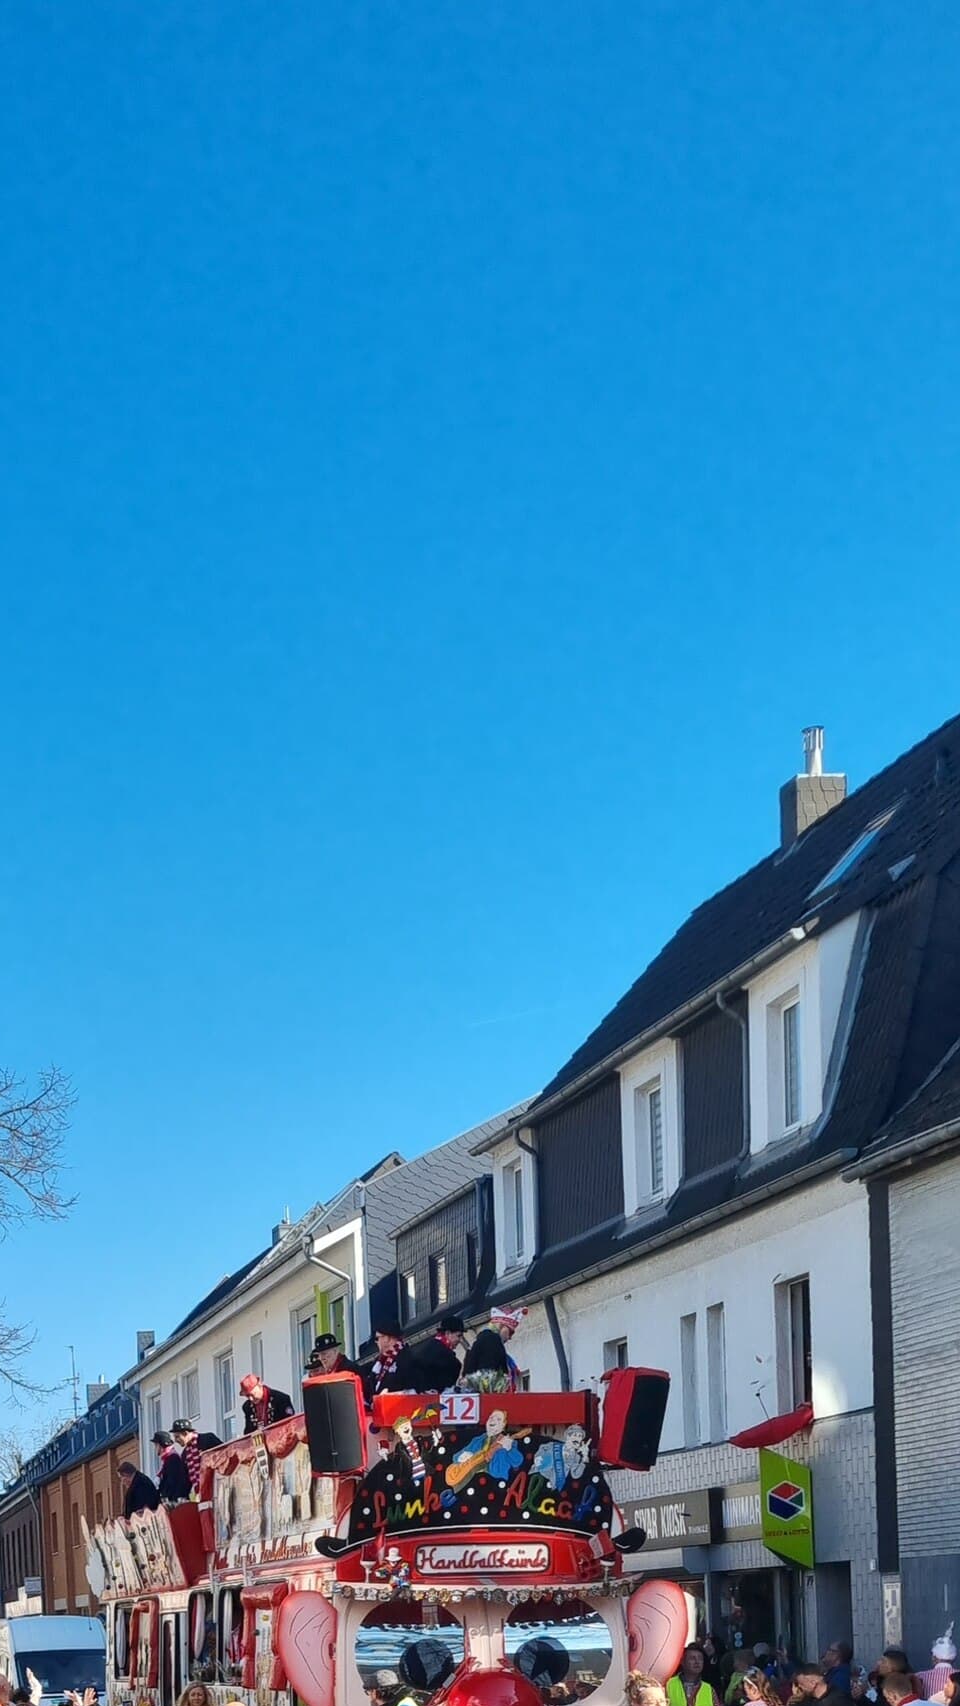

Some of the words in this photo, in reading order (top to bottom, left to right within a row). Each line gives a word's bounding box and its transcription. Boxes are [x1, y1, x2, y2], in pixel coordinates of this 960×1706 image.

[443, 1397, 475, 1421] 12
[660, 1502, 687, 1538] KIOSK
[722, 1494, 762, 1529] MINIMAR
